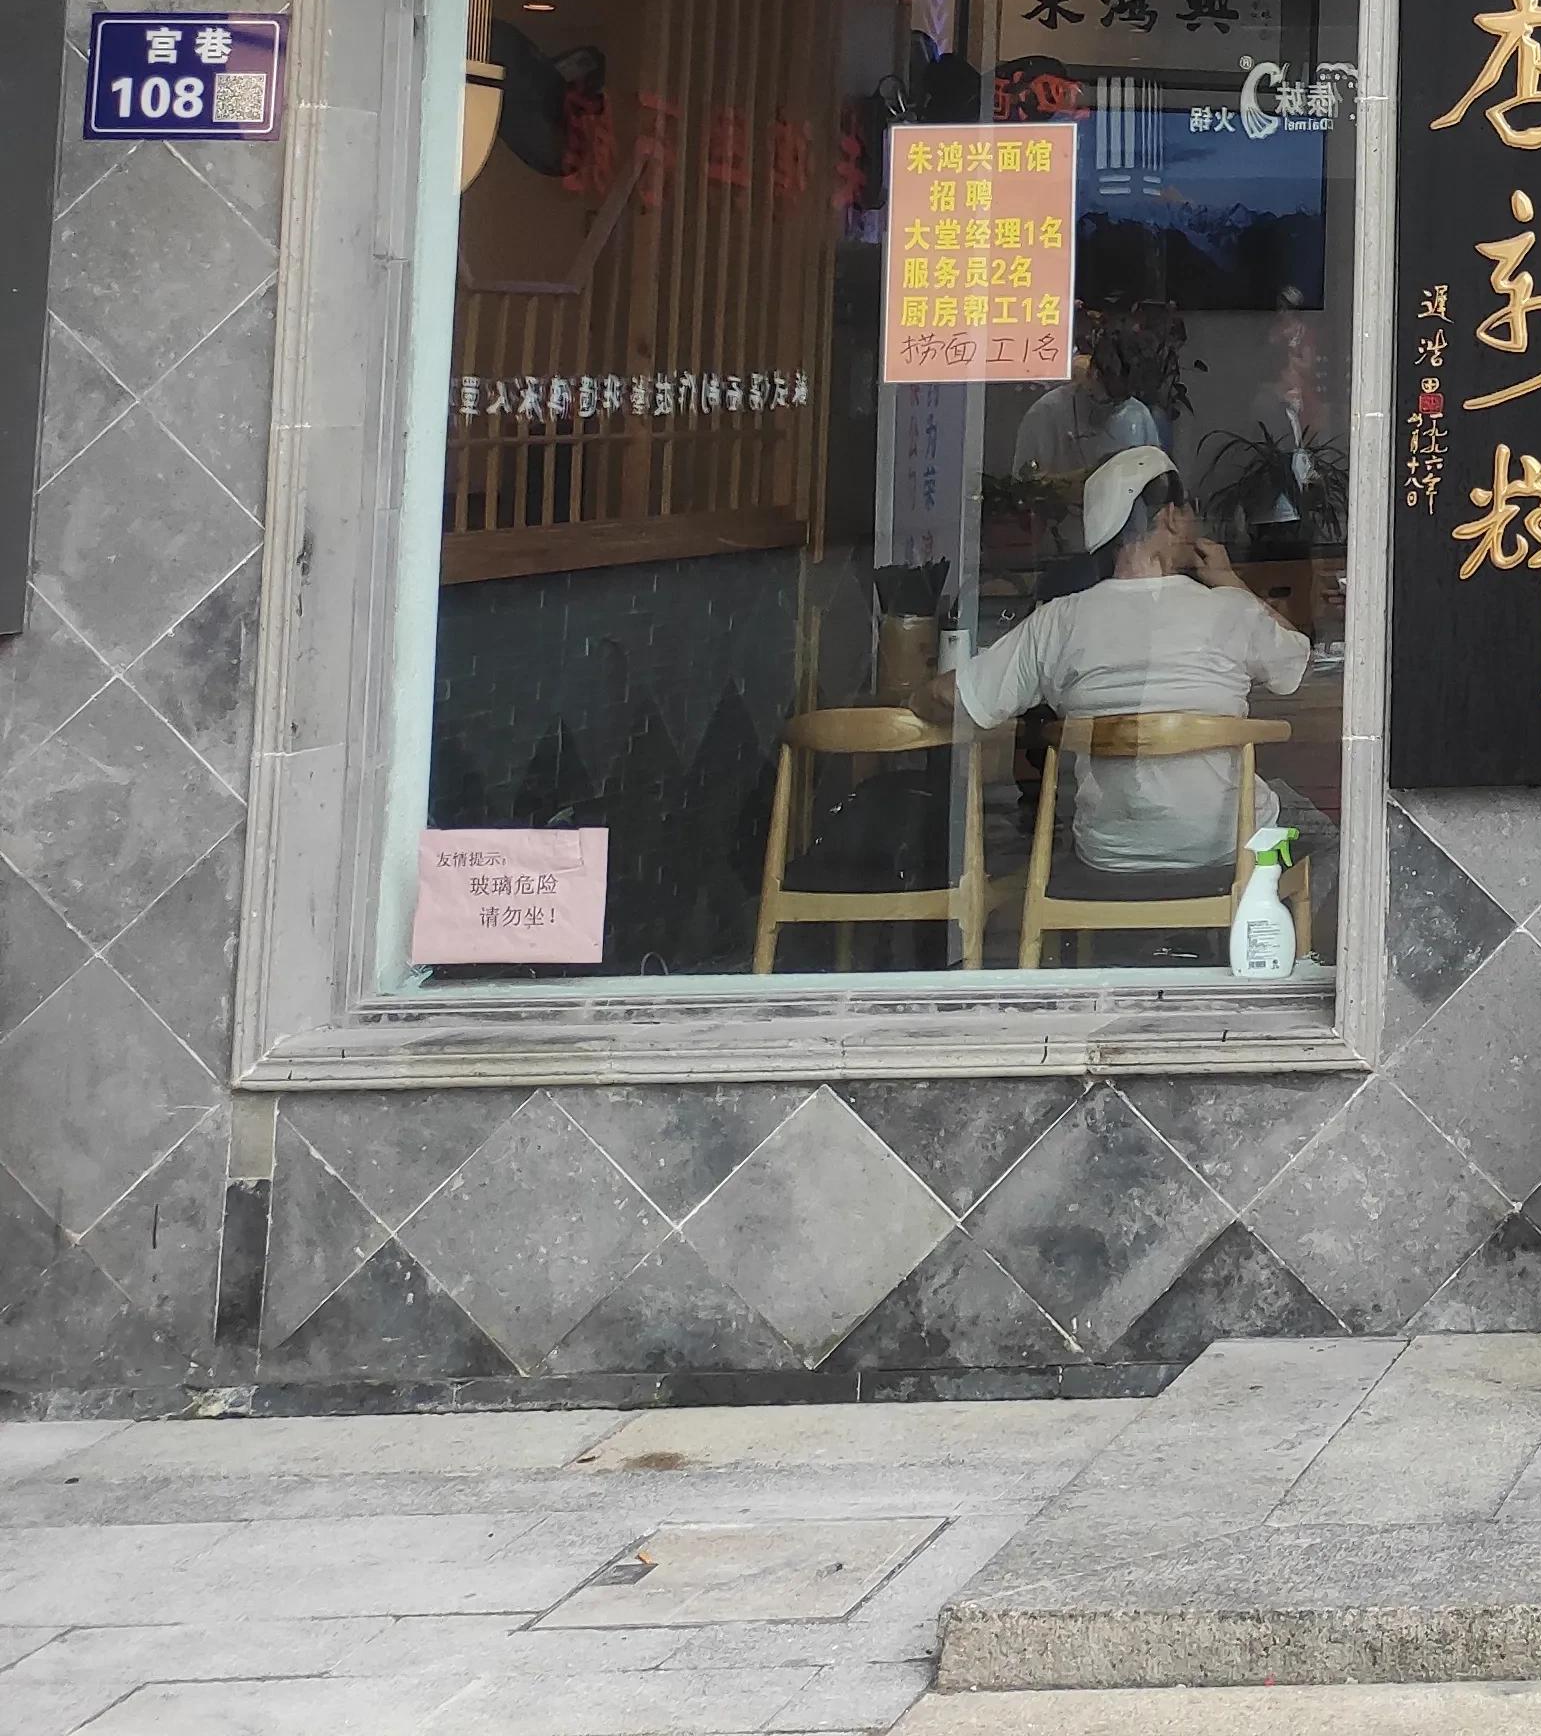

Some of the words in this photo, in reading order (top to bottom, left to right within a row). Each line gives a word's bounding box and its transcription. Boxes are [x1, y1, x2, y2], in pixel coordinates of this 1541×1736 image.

[145, 26, 233, 64] 宫巷
[111, 76, 205, 118] 108
[907, 139, 1054, 173] 朱鸿兴面馆
[929, 180, 994, 213] 招聘
[904, 218, 1064, 250] 大堂经理1名
[902, 255, 1034, 289] 服务员2名
[900, 295, 1061, 328] 厨房帮工1名
[470, 873, 559, 896] 玻璃危险
[480, 906, 556, 928] 请勿坐！
